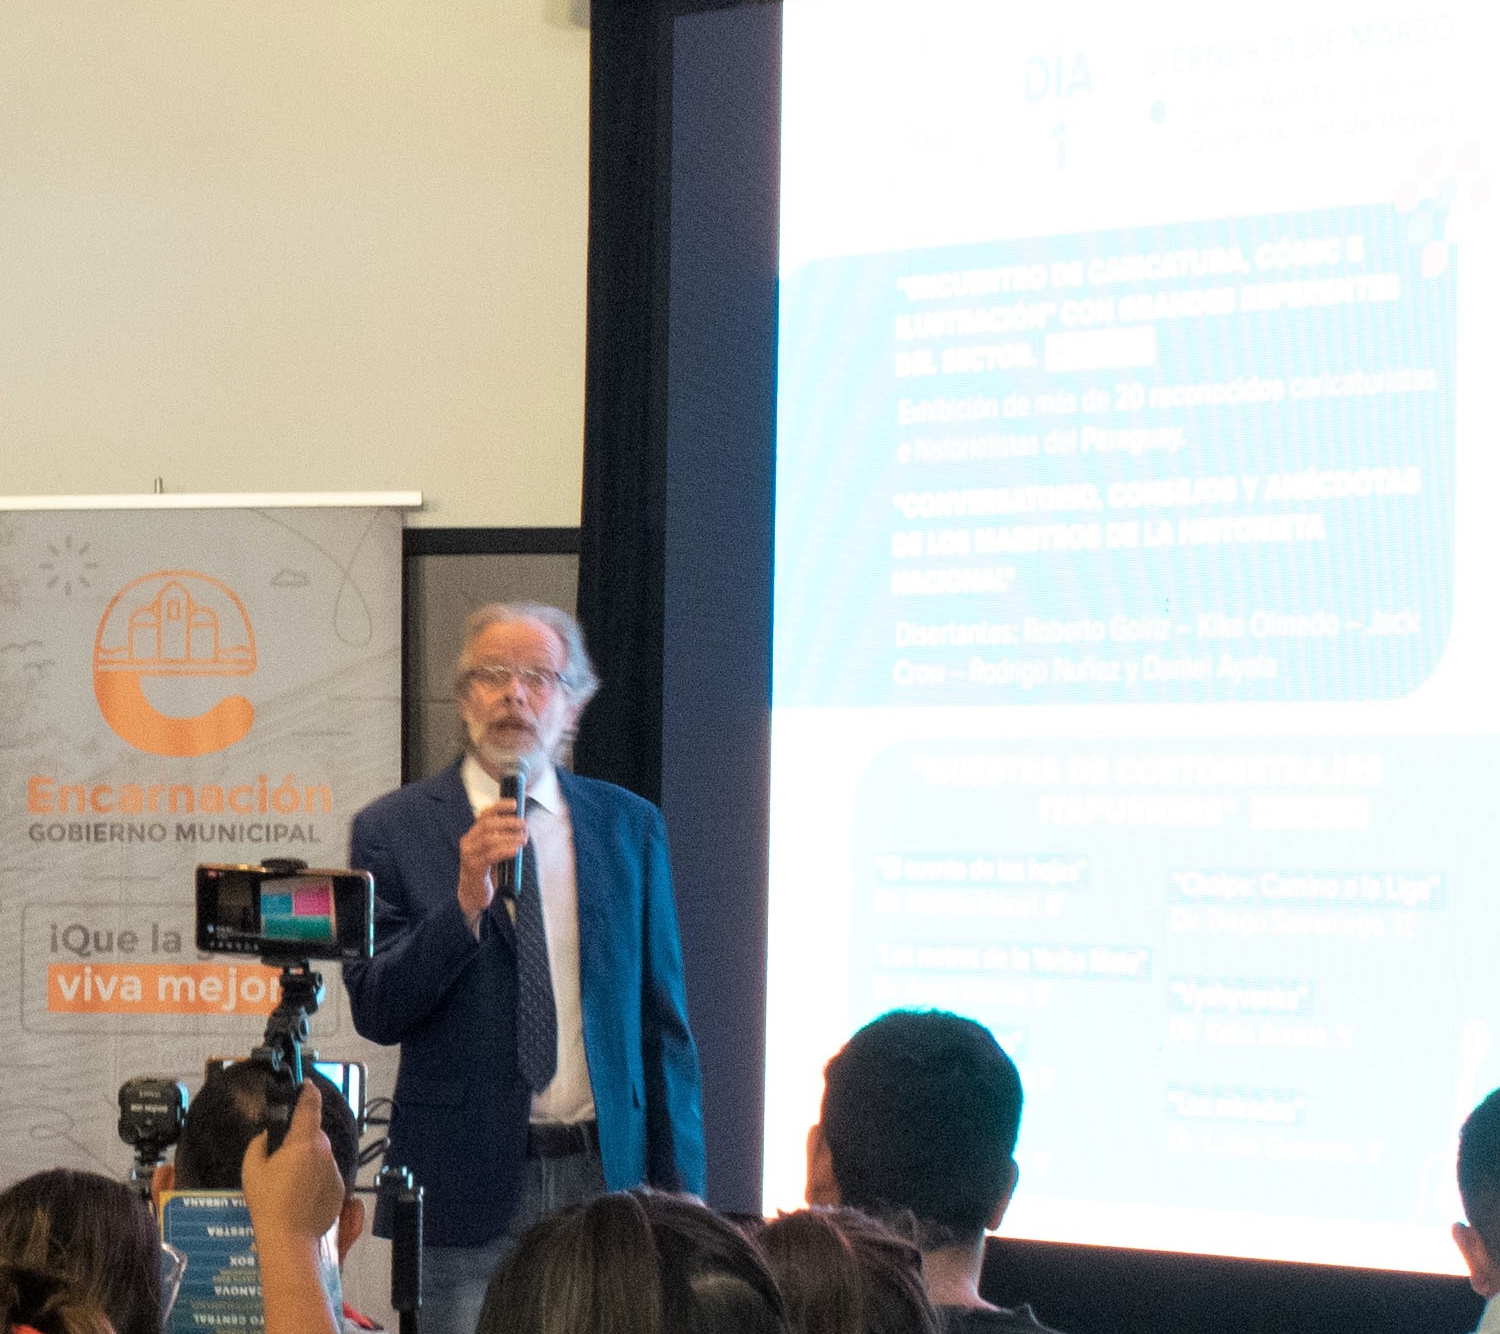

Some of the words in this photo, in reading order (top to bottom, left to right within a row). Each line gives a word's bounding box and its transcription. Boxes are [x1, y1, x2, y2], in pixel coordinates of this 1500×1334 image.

[1061, 297, 1114, 326] CON
[1002, 392, 1031, 419] de
[1082, 388, 1110, 414] de
[1115, 382, 1146, 411] 20
[1150, 375, 1284, 409] reconocidos
[1143, 518, 1174, 547] LA
[1023, 618, 1105, 644] Roberto
[27, 774, 332, 816] Encarnación
[28, 822, 168, 844] GOBIERNO
[175, 823, 321, 845] MUNICIPAL
[51, 923, 140, 955] ¡Que
[151, 923, 182, 955] la
[57, 968, 142, 1003] viva
